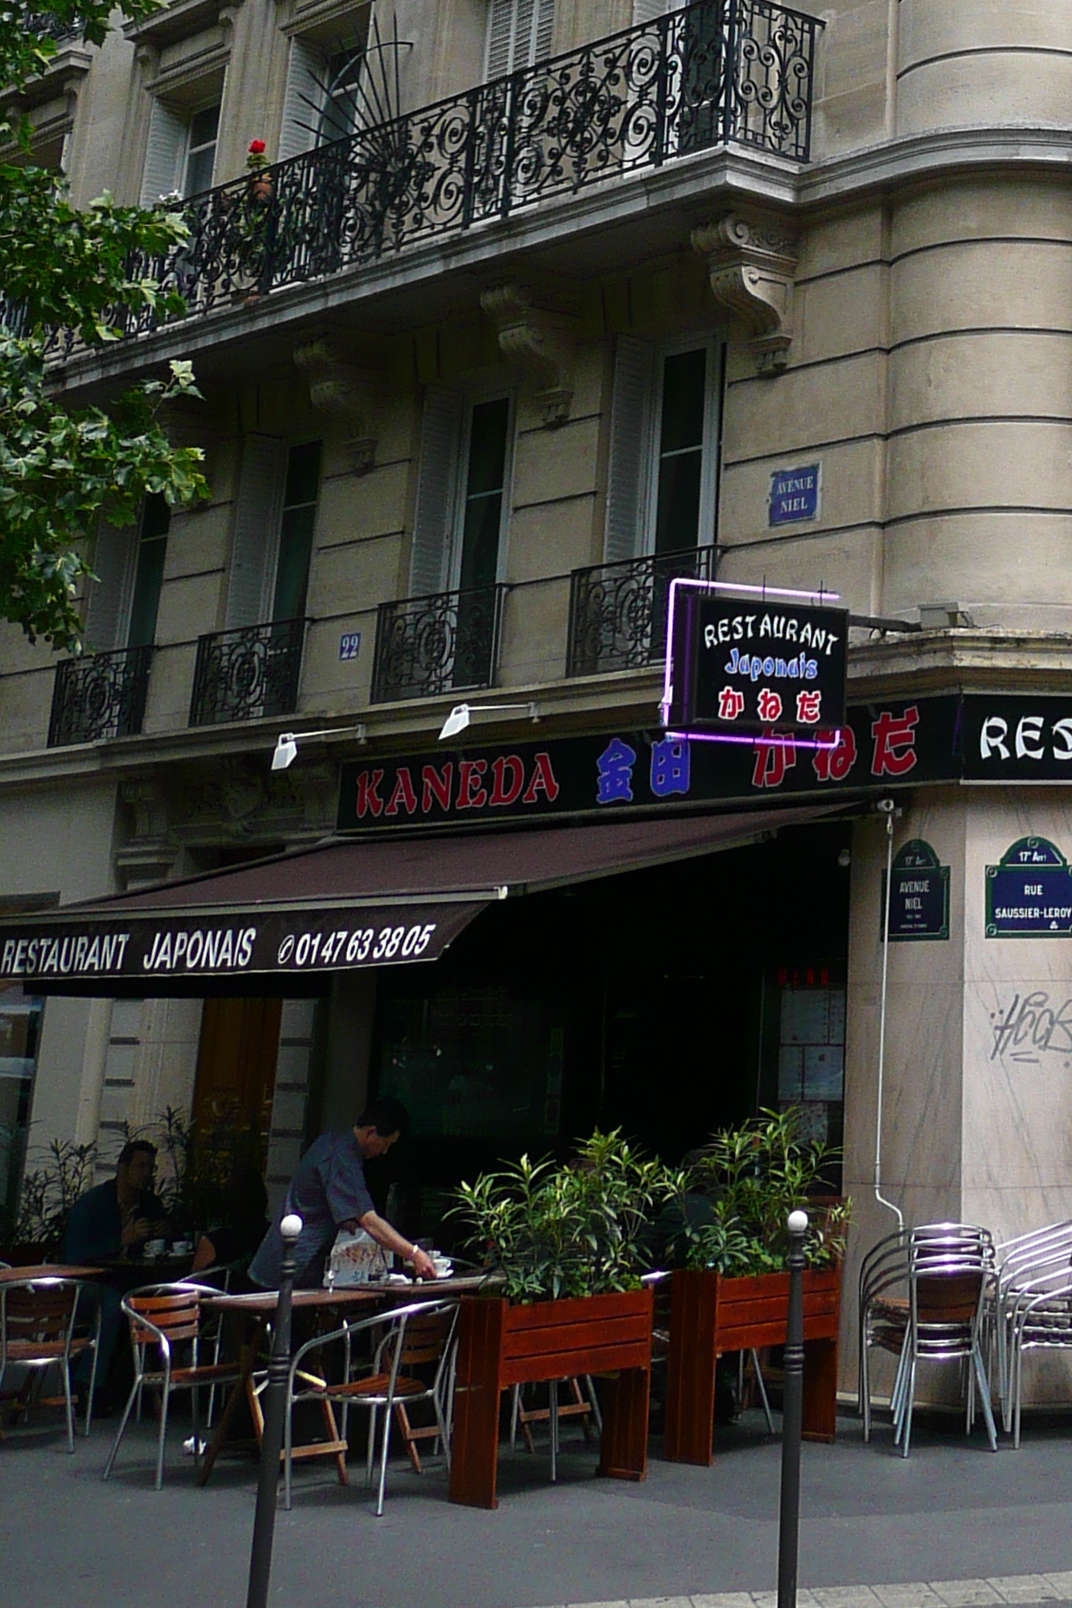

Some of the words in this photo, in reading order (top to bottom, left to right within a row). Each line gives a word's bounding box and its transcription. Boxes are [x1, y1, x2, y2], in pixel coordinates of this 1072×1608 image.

[776, 475, 814, 495] AVENUE
[780, 496, 808, 514] NIEL
[704, 613, 839, 656] RESTAURANT
[341, 635, 359, 659] 22
[724, 647, 818, 682] Japonais
[718, 686, 822, 722] かねだ
[355, 752, 560, 818] KANEDA
[596, 737, 691, 804] 金田
[899, 880, 930, 894] AVENUE
[1024, 884, 1044, 896] RUE
[904, 897, 922, 910] NIEL
[994, 907, 1072, 919] SAUSSIER-LEROY
[0, 933, 130, 974] RESTAURANT
[143, 927, 257, 970] JAPONAIS
[346, 928, 374, 962] 63
[372, 926, 405, 959] 38
[401, 923, 436, 956] 05
